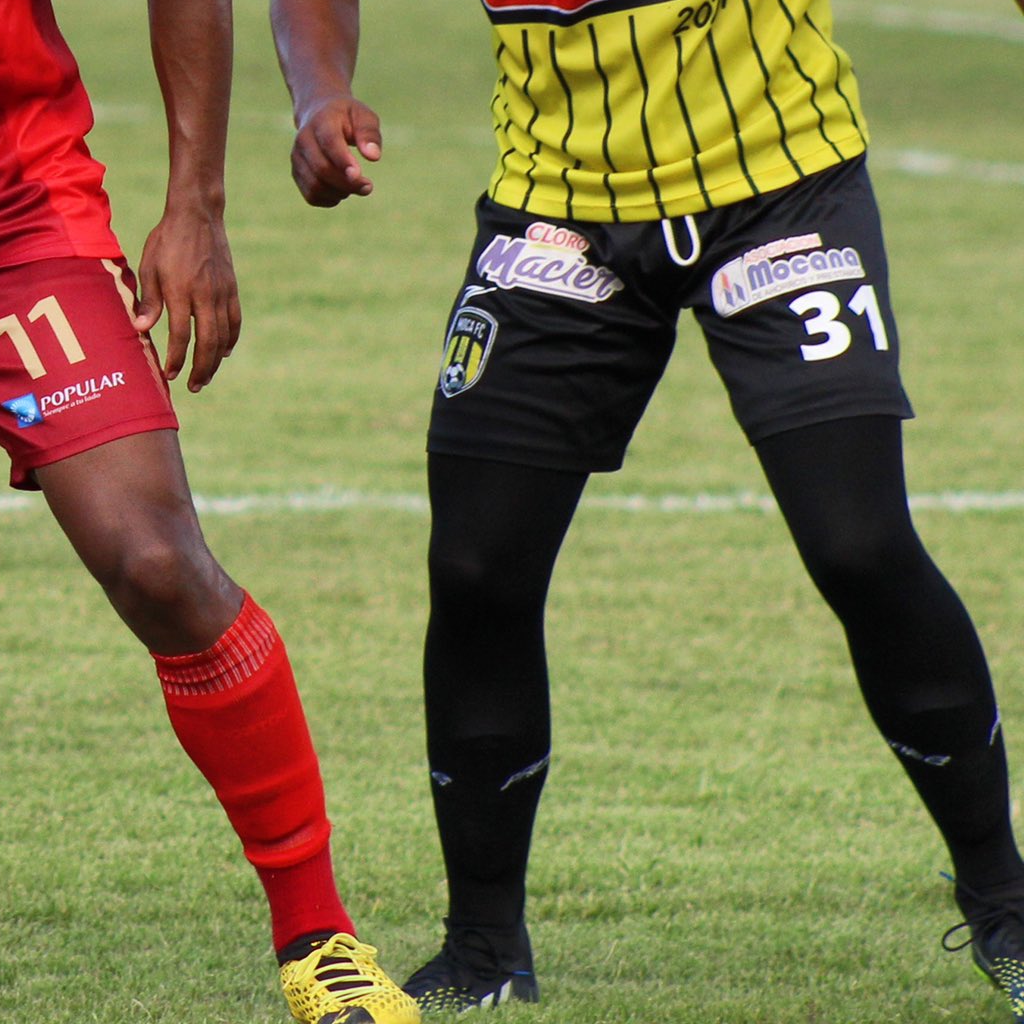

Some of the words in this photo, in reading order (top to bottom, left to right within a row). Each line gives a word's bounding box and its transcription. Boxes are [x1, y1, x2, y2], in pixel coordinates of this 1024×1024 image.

[527, 224, 589, 251] CLORO
[788, 284, 889, 362] 31
[40, 372, 125, 411] POPULAR
